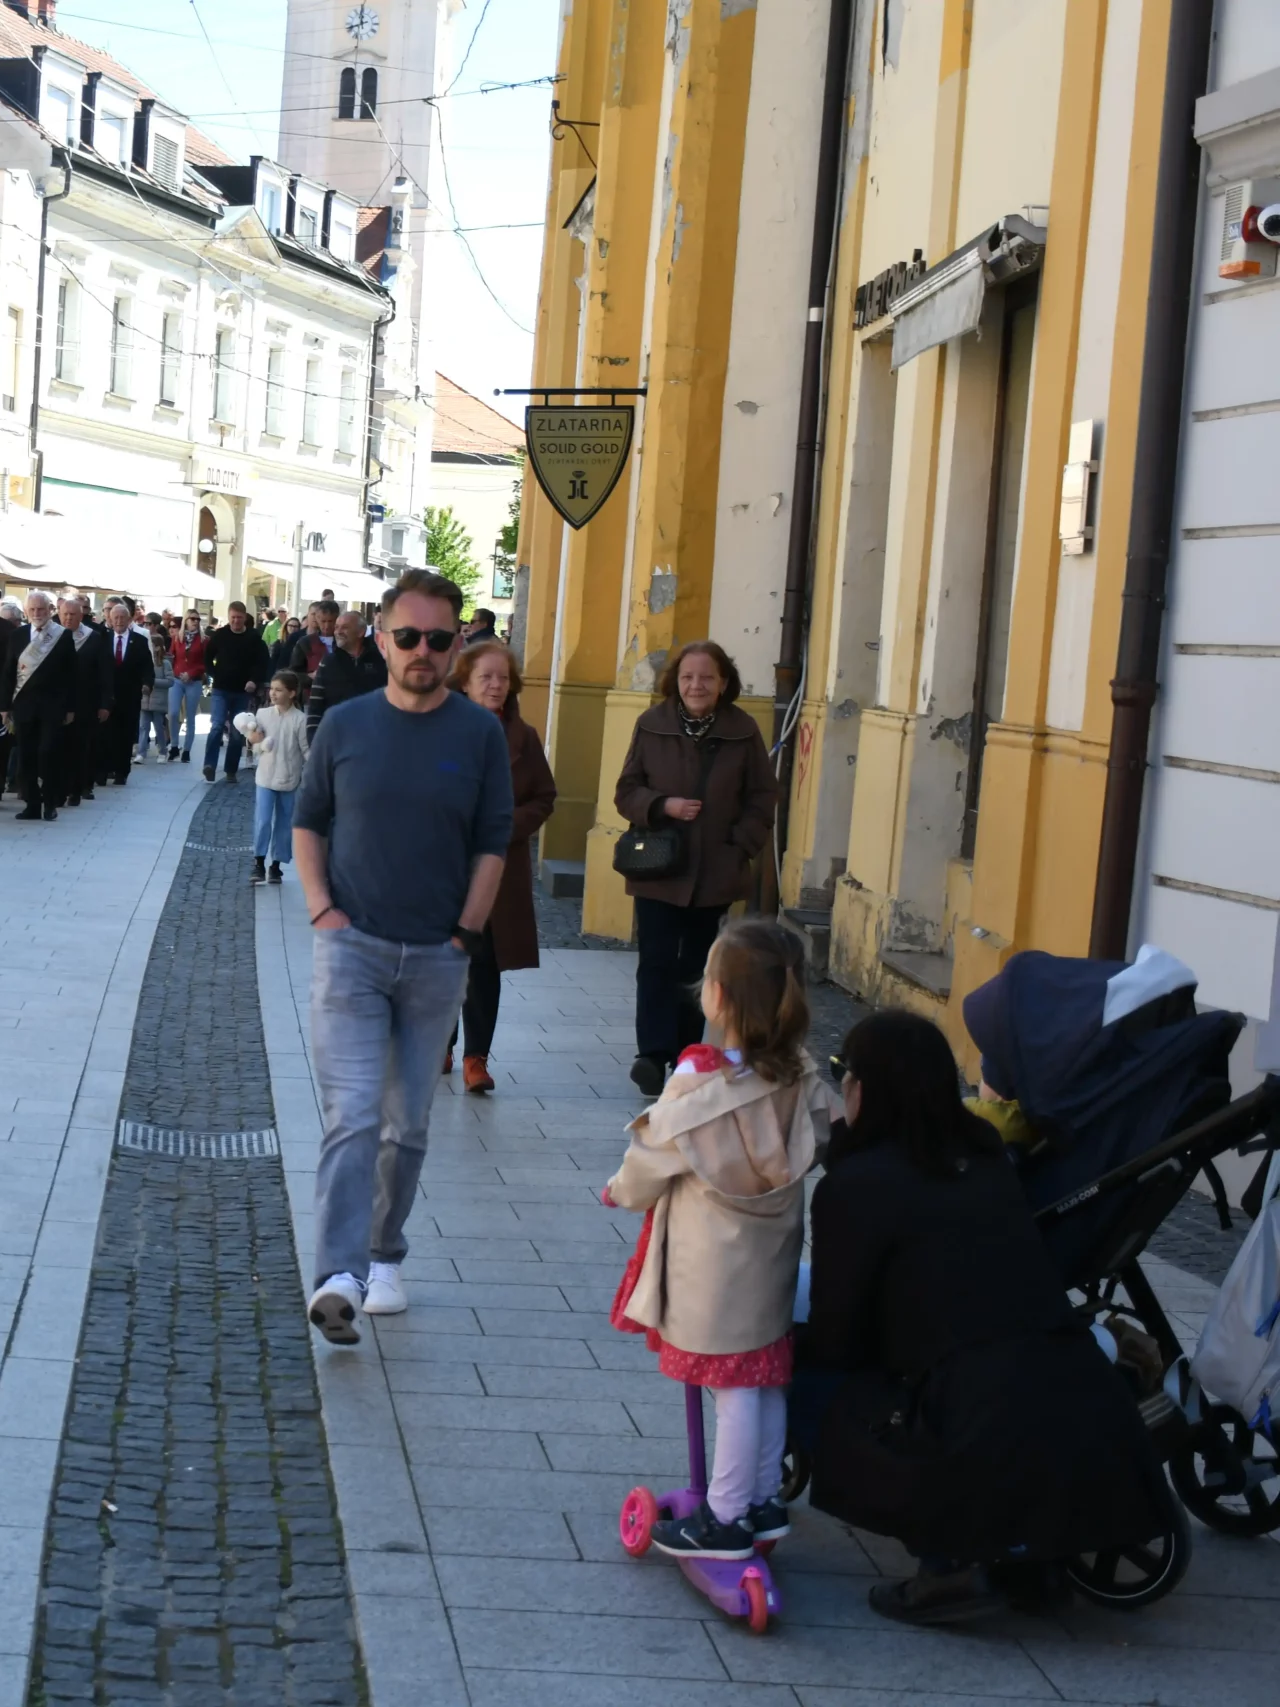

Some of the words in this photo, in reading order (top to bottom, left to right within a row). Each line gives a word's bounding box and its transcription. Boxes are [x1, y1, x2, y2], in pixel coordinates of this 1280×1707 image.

[539, 443, 577, 454] SOLID
[581, 443, 619, 454] GOLD
[206, 467, 221, 486] OLD
[222, 470, 240, 490] CITY
